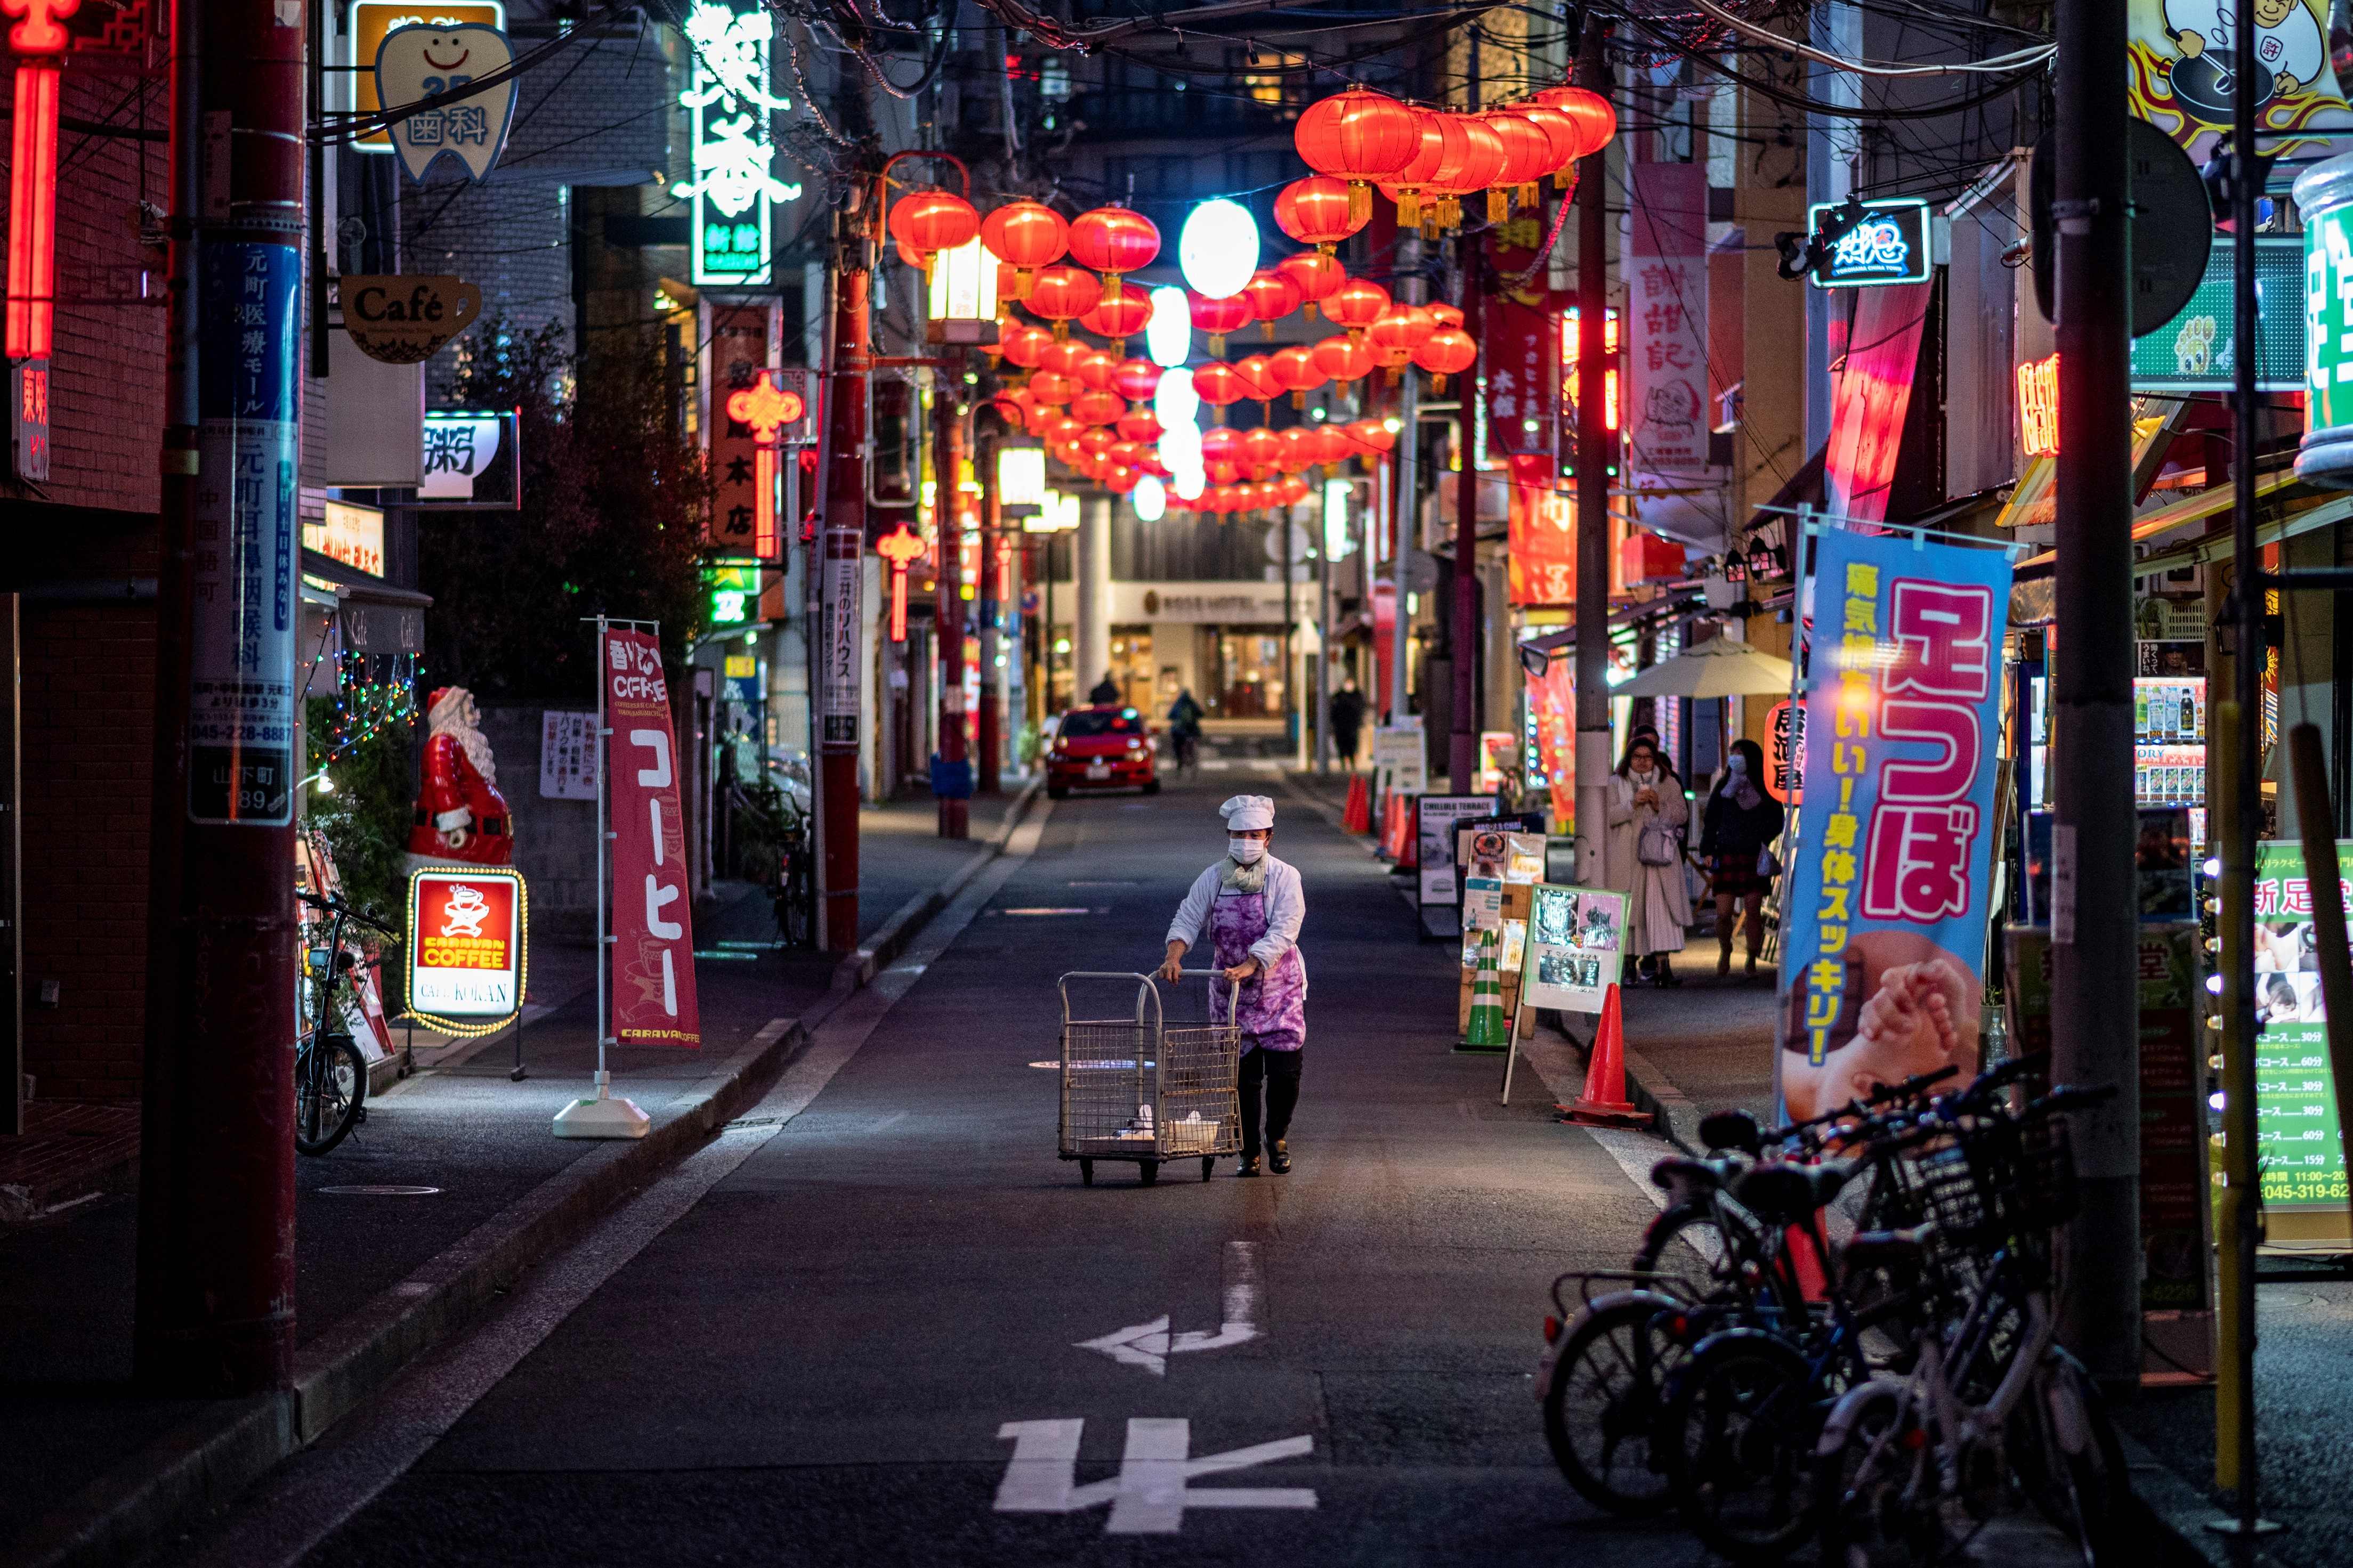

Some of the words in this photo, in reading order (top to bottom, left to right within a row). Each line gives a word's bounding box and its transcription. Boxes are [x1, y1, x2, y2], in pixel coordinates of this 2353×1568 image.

[2264, 40, 2279, 58] 許
[407, 106, 487, 145] 歯科
[354, 285, 444, 321] Café
[242, 249, 268, 415] 元町医療モール
[23, 367, 47, 426] 東明
[197, 489, 219, 603] 中国語可
[232, 443, 265, 673] 元町耳鼻咽喉科
[837, 564, 851, 678] 三井のリハウス
[192, 725, 291, 741] 045-228-8887
[1861, 578, 1993, 923] 足つぼ
[2135, 749, 2165, 758] ORY
[213, 765, 275, 786] 山下町
[1424, 802, 1457, 810] CHILLULU
[1458, 802, 1490, 810] TERRACE
[630, 729, 683, 1017] コーヒー
[424, 937, 505, 949] CARAVAN
[424, 948, 504, 969] COFFEE
[2257, 1032, 2289, 1043] コース
[2301, 1031, 2323, 1042] 30分
[2301, 1057, 2323, 1067] 60分
[2302, 1081, 2323, 1092] 30分
[2302, 1106, 2324, 1116] 30分
[2302, 1130, 2324, 1141] 60分
[2304, 1155, 2325, 1165] 15分
